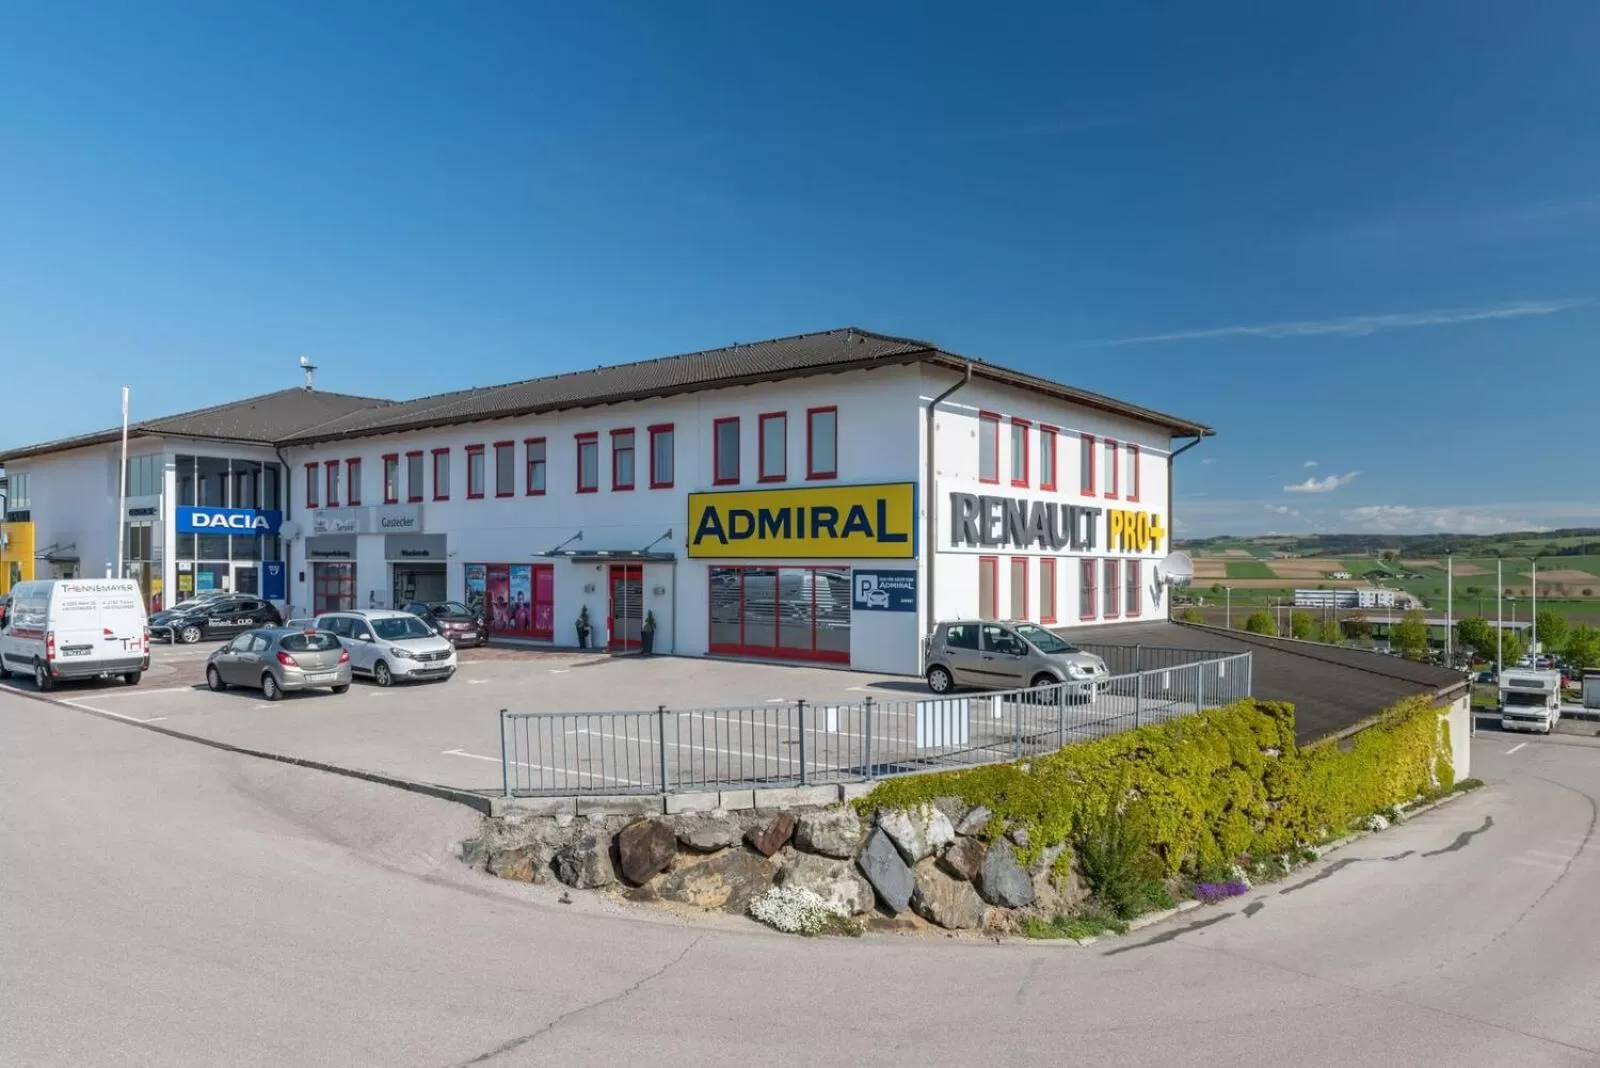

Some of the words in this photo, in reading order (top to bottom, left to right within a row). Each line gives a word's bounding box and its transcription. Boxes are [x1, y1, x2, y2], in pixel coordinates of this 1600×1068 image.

[192, 512, 270, 529] DACIA
[693, 499, 908, 545] ADMIRAL
[950, 491, 1102, 552] RENAULT
[61, 584, 133, 593] THENNEMAYER
[879, 581, 914, 589] ADMIRAL
